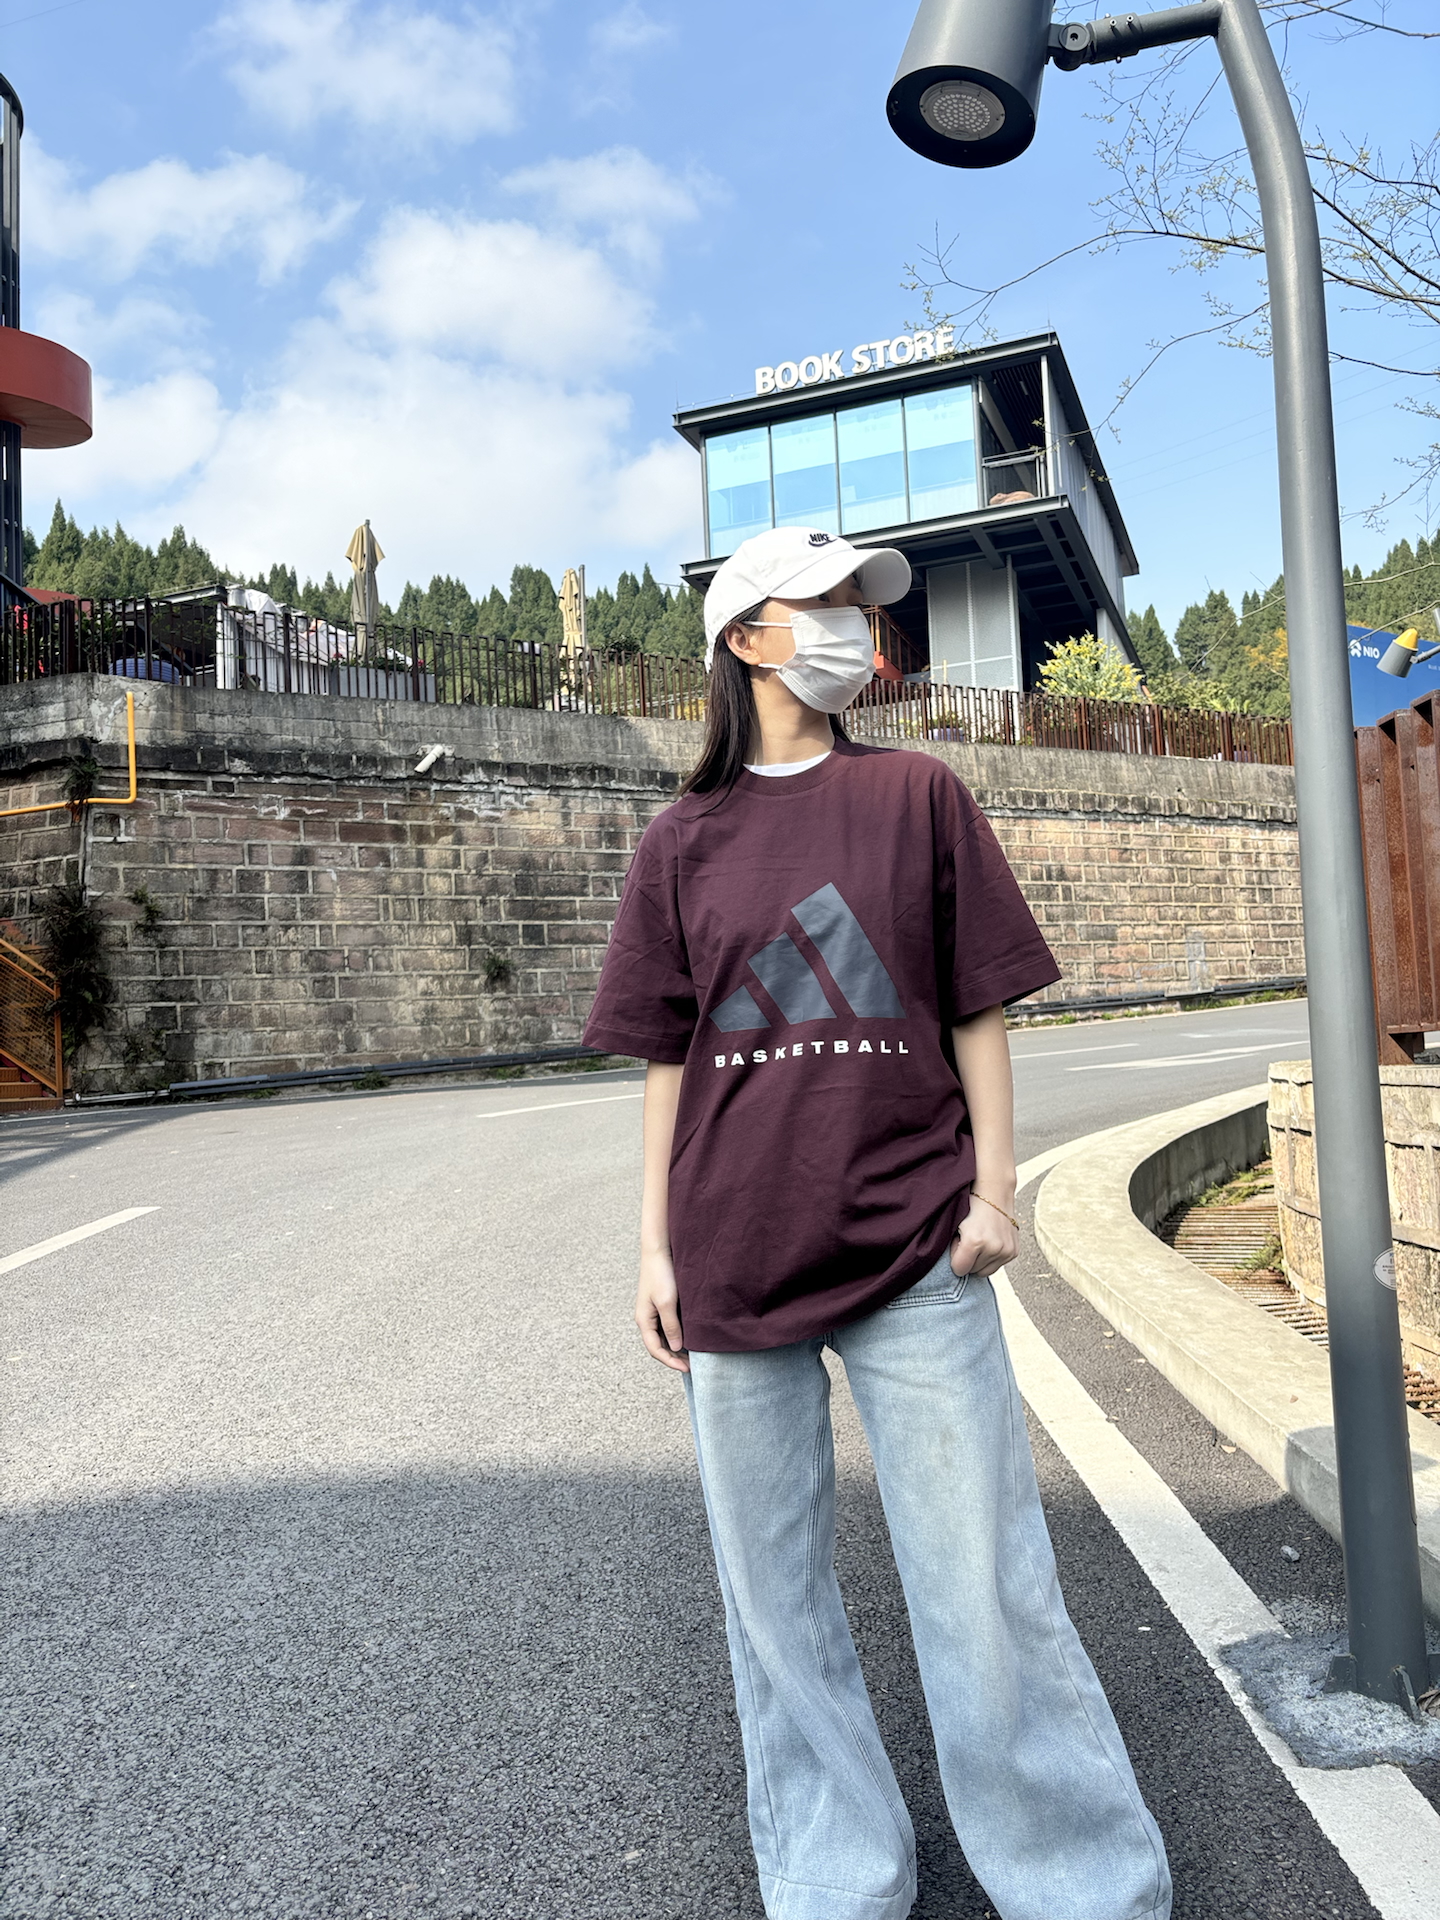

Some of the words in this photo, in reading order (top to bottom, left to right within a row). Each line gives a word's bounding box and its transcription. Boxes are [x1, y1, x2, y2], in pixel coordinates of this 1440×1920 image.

[755, 350, 845, 395] BOOK
[852, 326, 955, 374] STORE
[809, 533, 830, 543] NIKE
[1363, 645, 1380, 659] NIO
[714, 1039, 909, 1068] BASKETBALL
